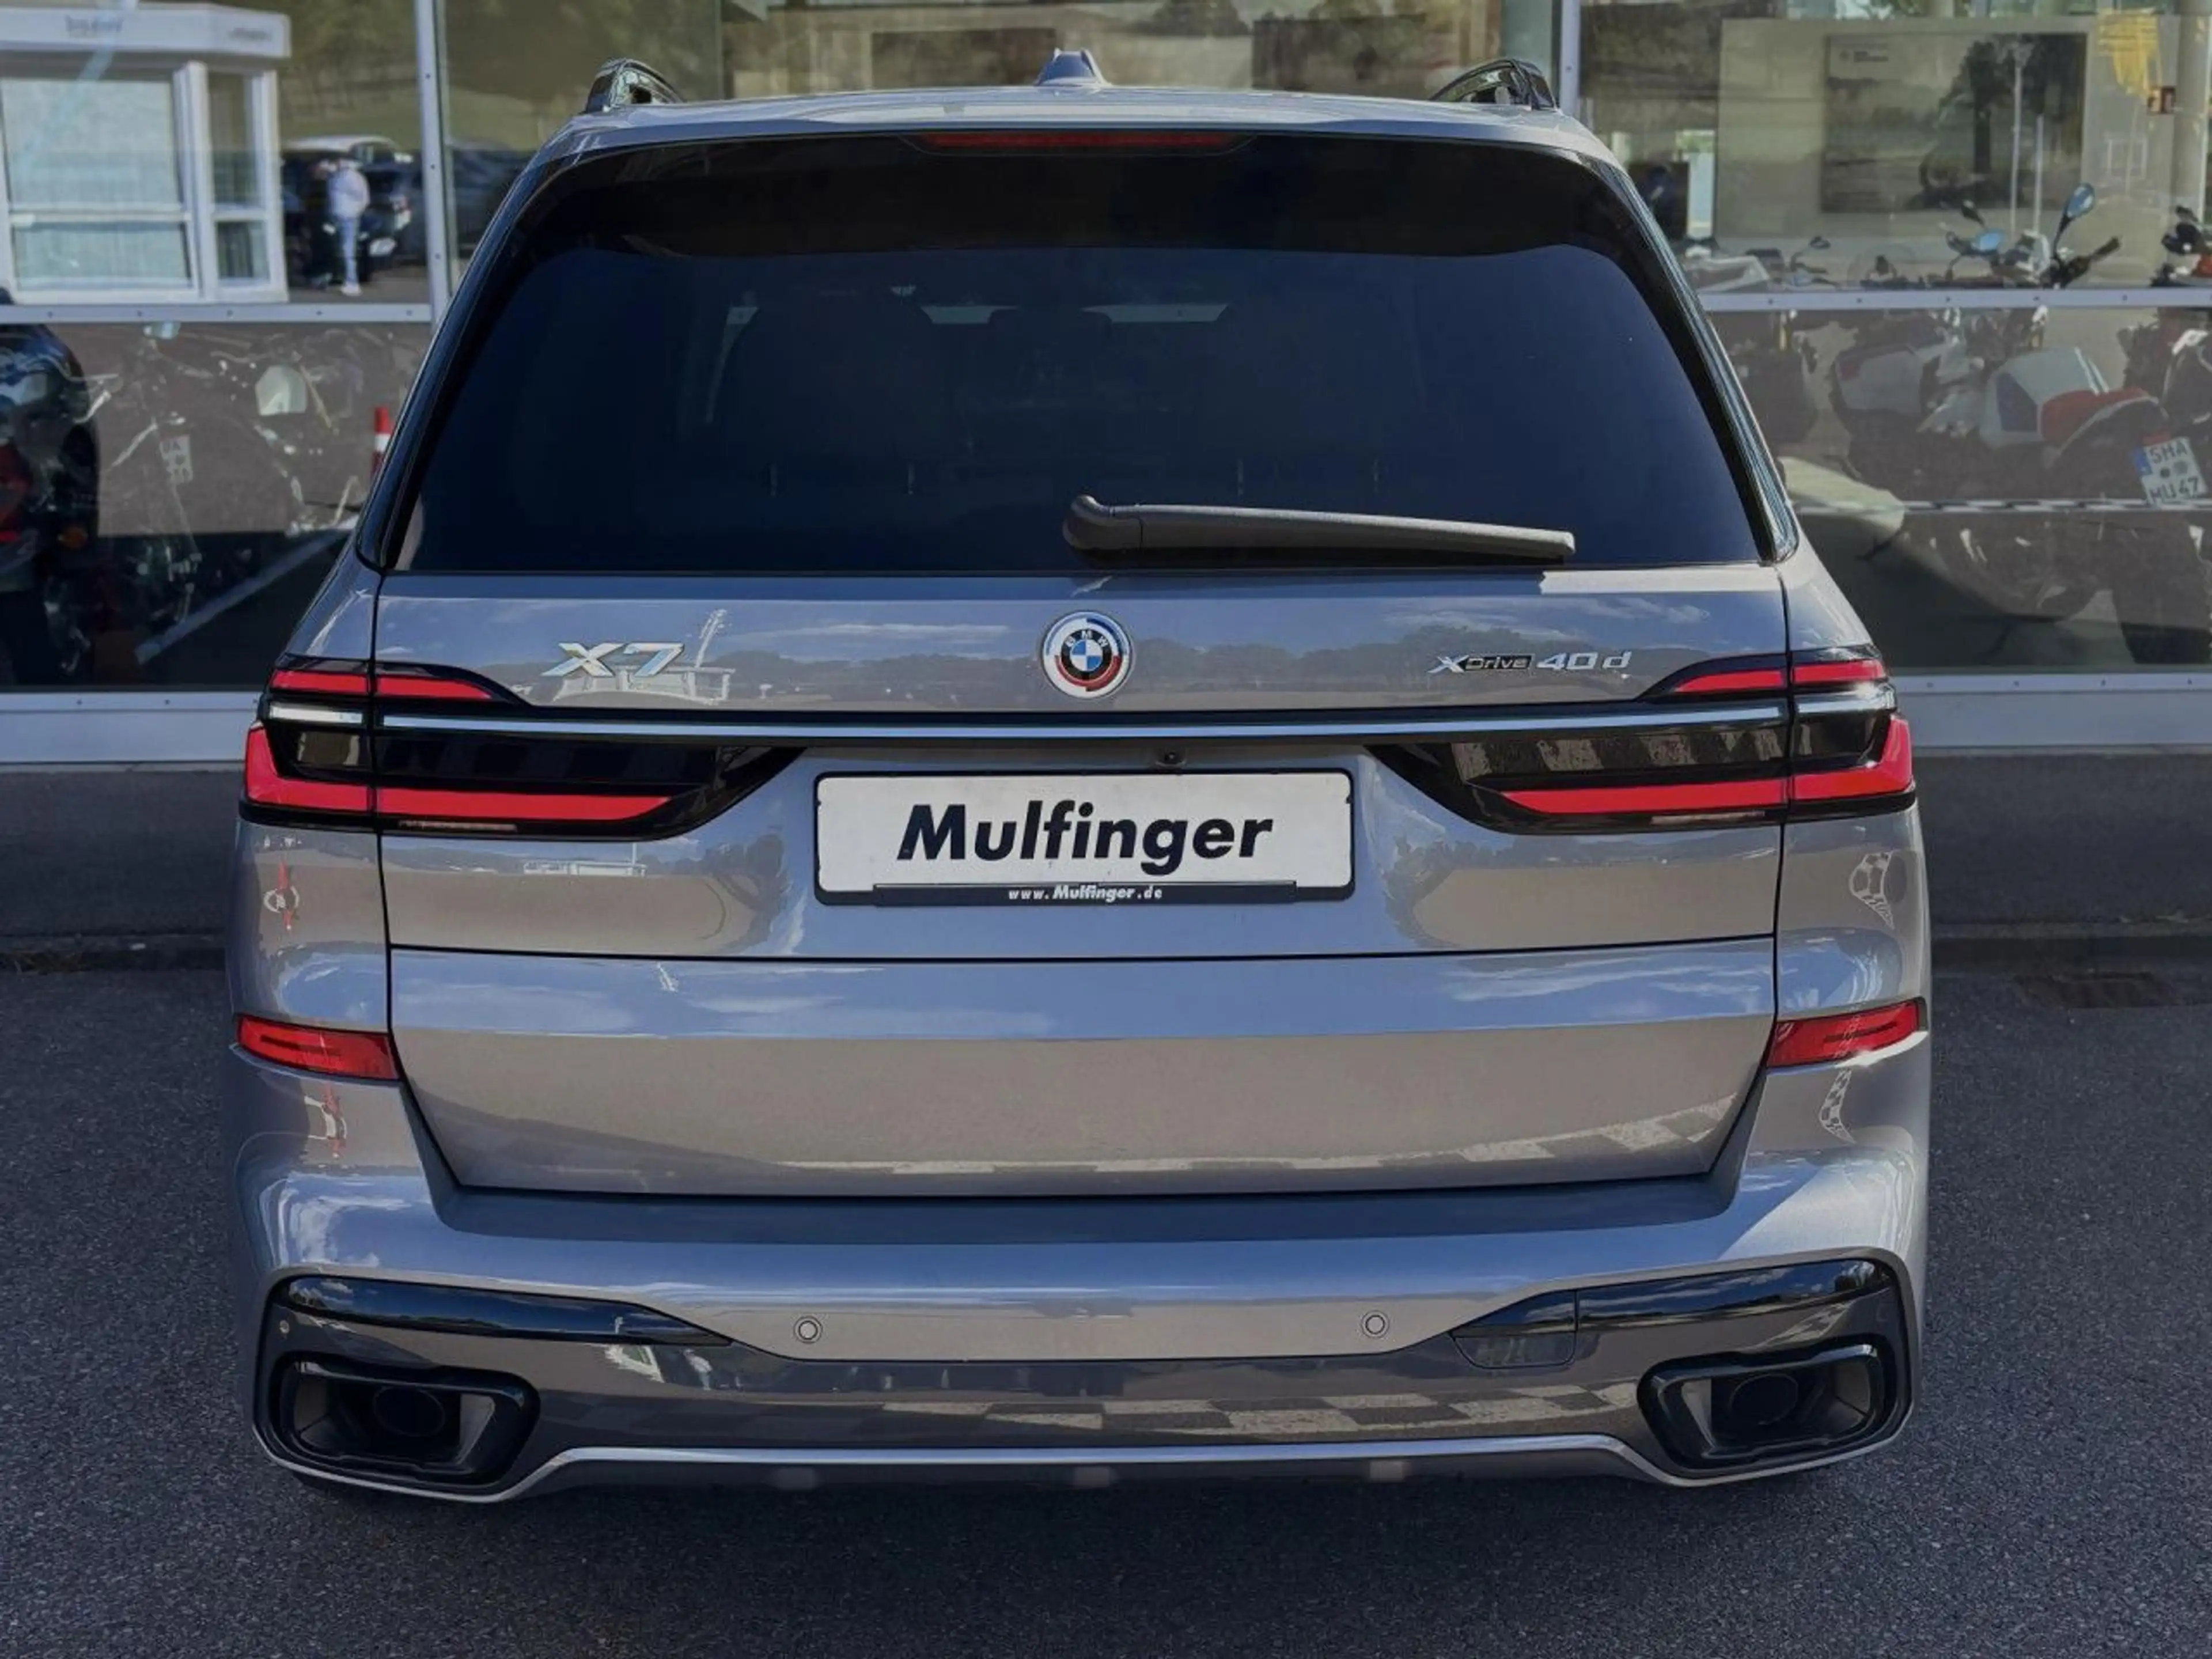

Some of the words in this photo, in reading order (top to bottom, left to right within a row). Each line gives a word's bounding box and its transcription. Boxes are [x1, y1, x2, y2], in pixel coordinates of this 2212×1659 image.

[540, 642, 685, 677] X7
[896, 800, 1274, 876] Mulfinger
[1008, 884, 1162, 903] www.Mulfinger.de
